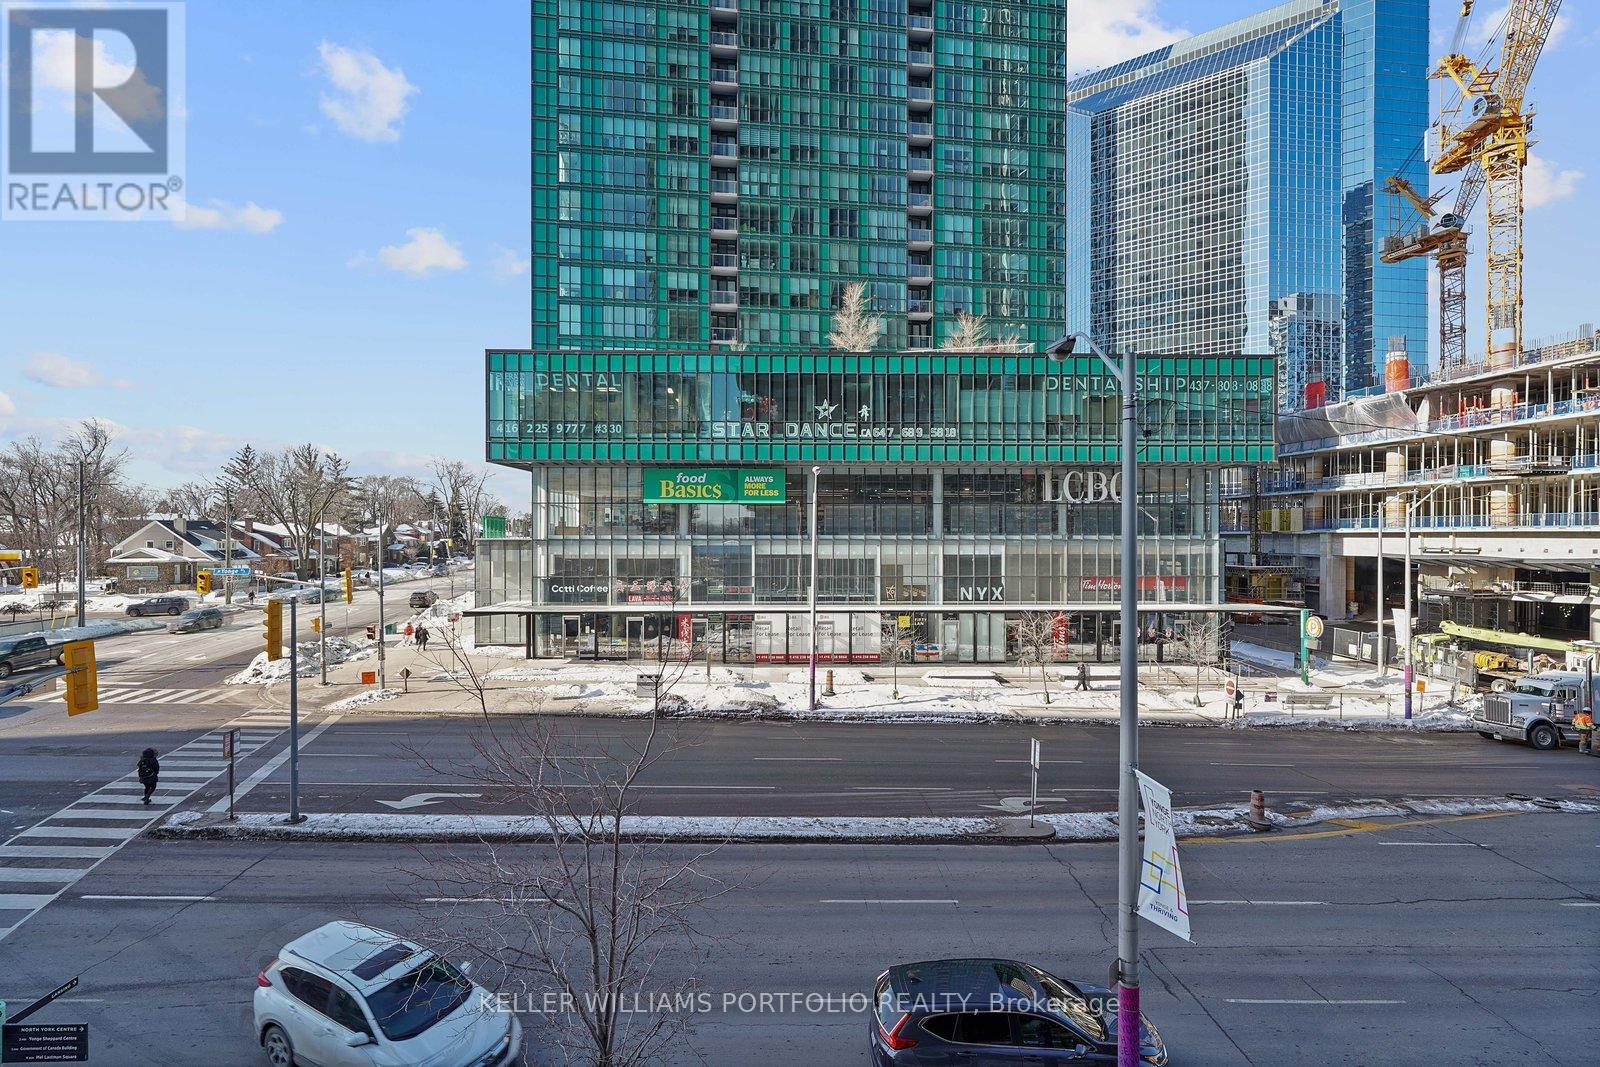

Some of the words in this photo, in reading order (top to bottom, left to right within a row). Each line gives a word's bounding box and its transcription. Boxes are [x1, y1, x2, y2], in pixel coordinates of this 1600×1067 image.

[536, 373, 622, 387] DENTAL
[496, 423, 518, 433] 416
[526, 423, 548, 433] 225
[556, 423, 586, 433] 9777
[594, 423, 622, 433] #330
[712, 422, 769, 437] STAR
[676, 472, 707, 483] food
[960, 587, 1004, 601] NYX
[1149, 903, 1179, 922] THRIVING
